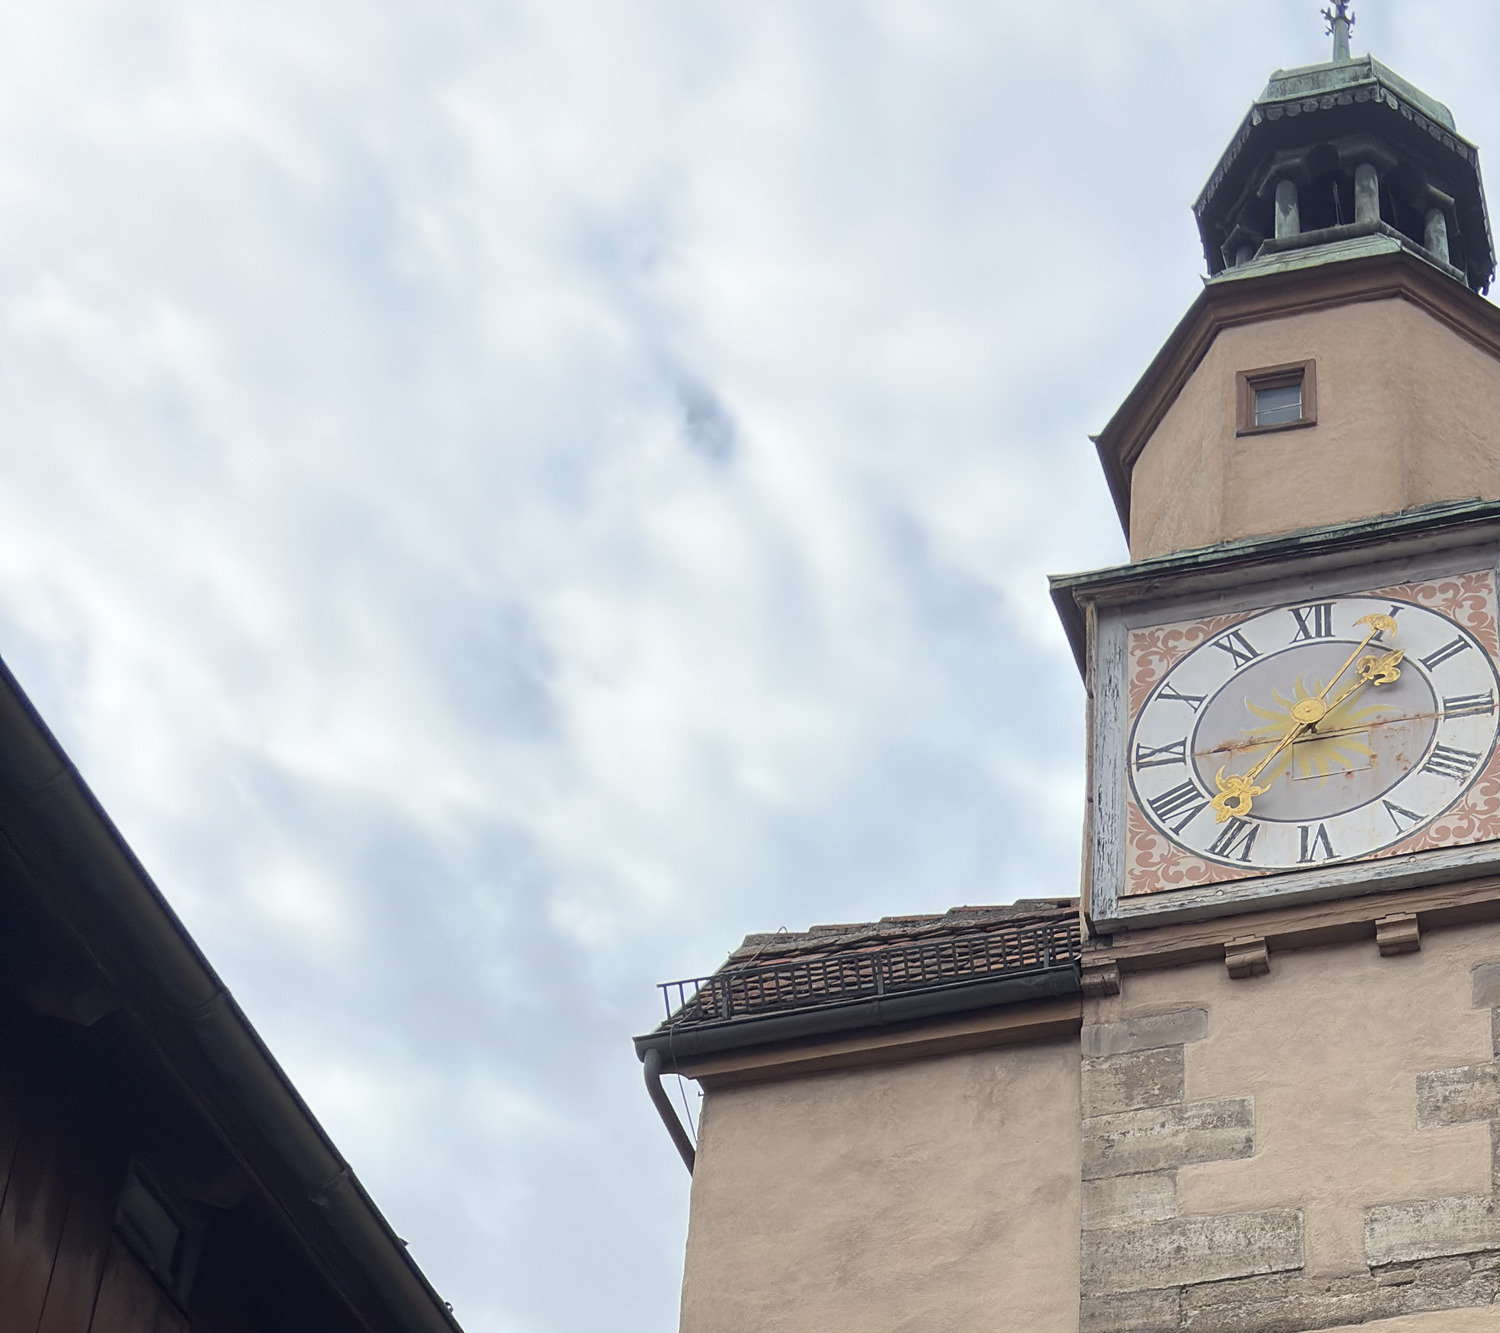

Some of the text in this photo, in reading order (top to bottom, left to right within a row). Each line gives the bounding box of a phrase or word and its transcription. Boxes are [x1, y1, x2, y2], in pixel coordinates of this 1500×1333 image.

[1287, 602, 1337, 645] XII
[1208, 628, 1263, 670] XI
[1418, 634, 1473, 672] II
[1155, 681, 1208, 713] X
[1441, 688, 1494, 723] III
[1136, 736, 1187, 772] IX
[1417, 741, 1482, 786] IIII
[1147, 777, 1211, 836] VIII
[1382, 799, 1428, 837] V
[1203, 816, 1260, 862] VII
[1296, 822, 1341, 864] VI
